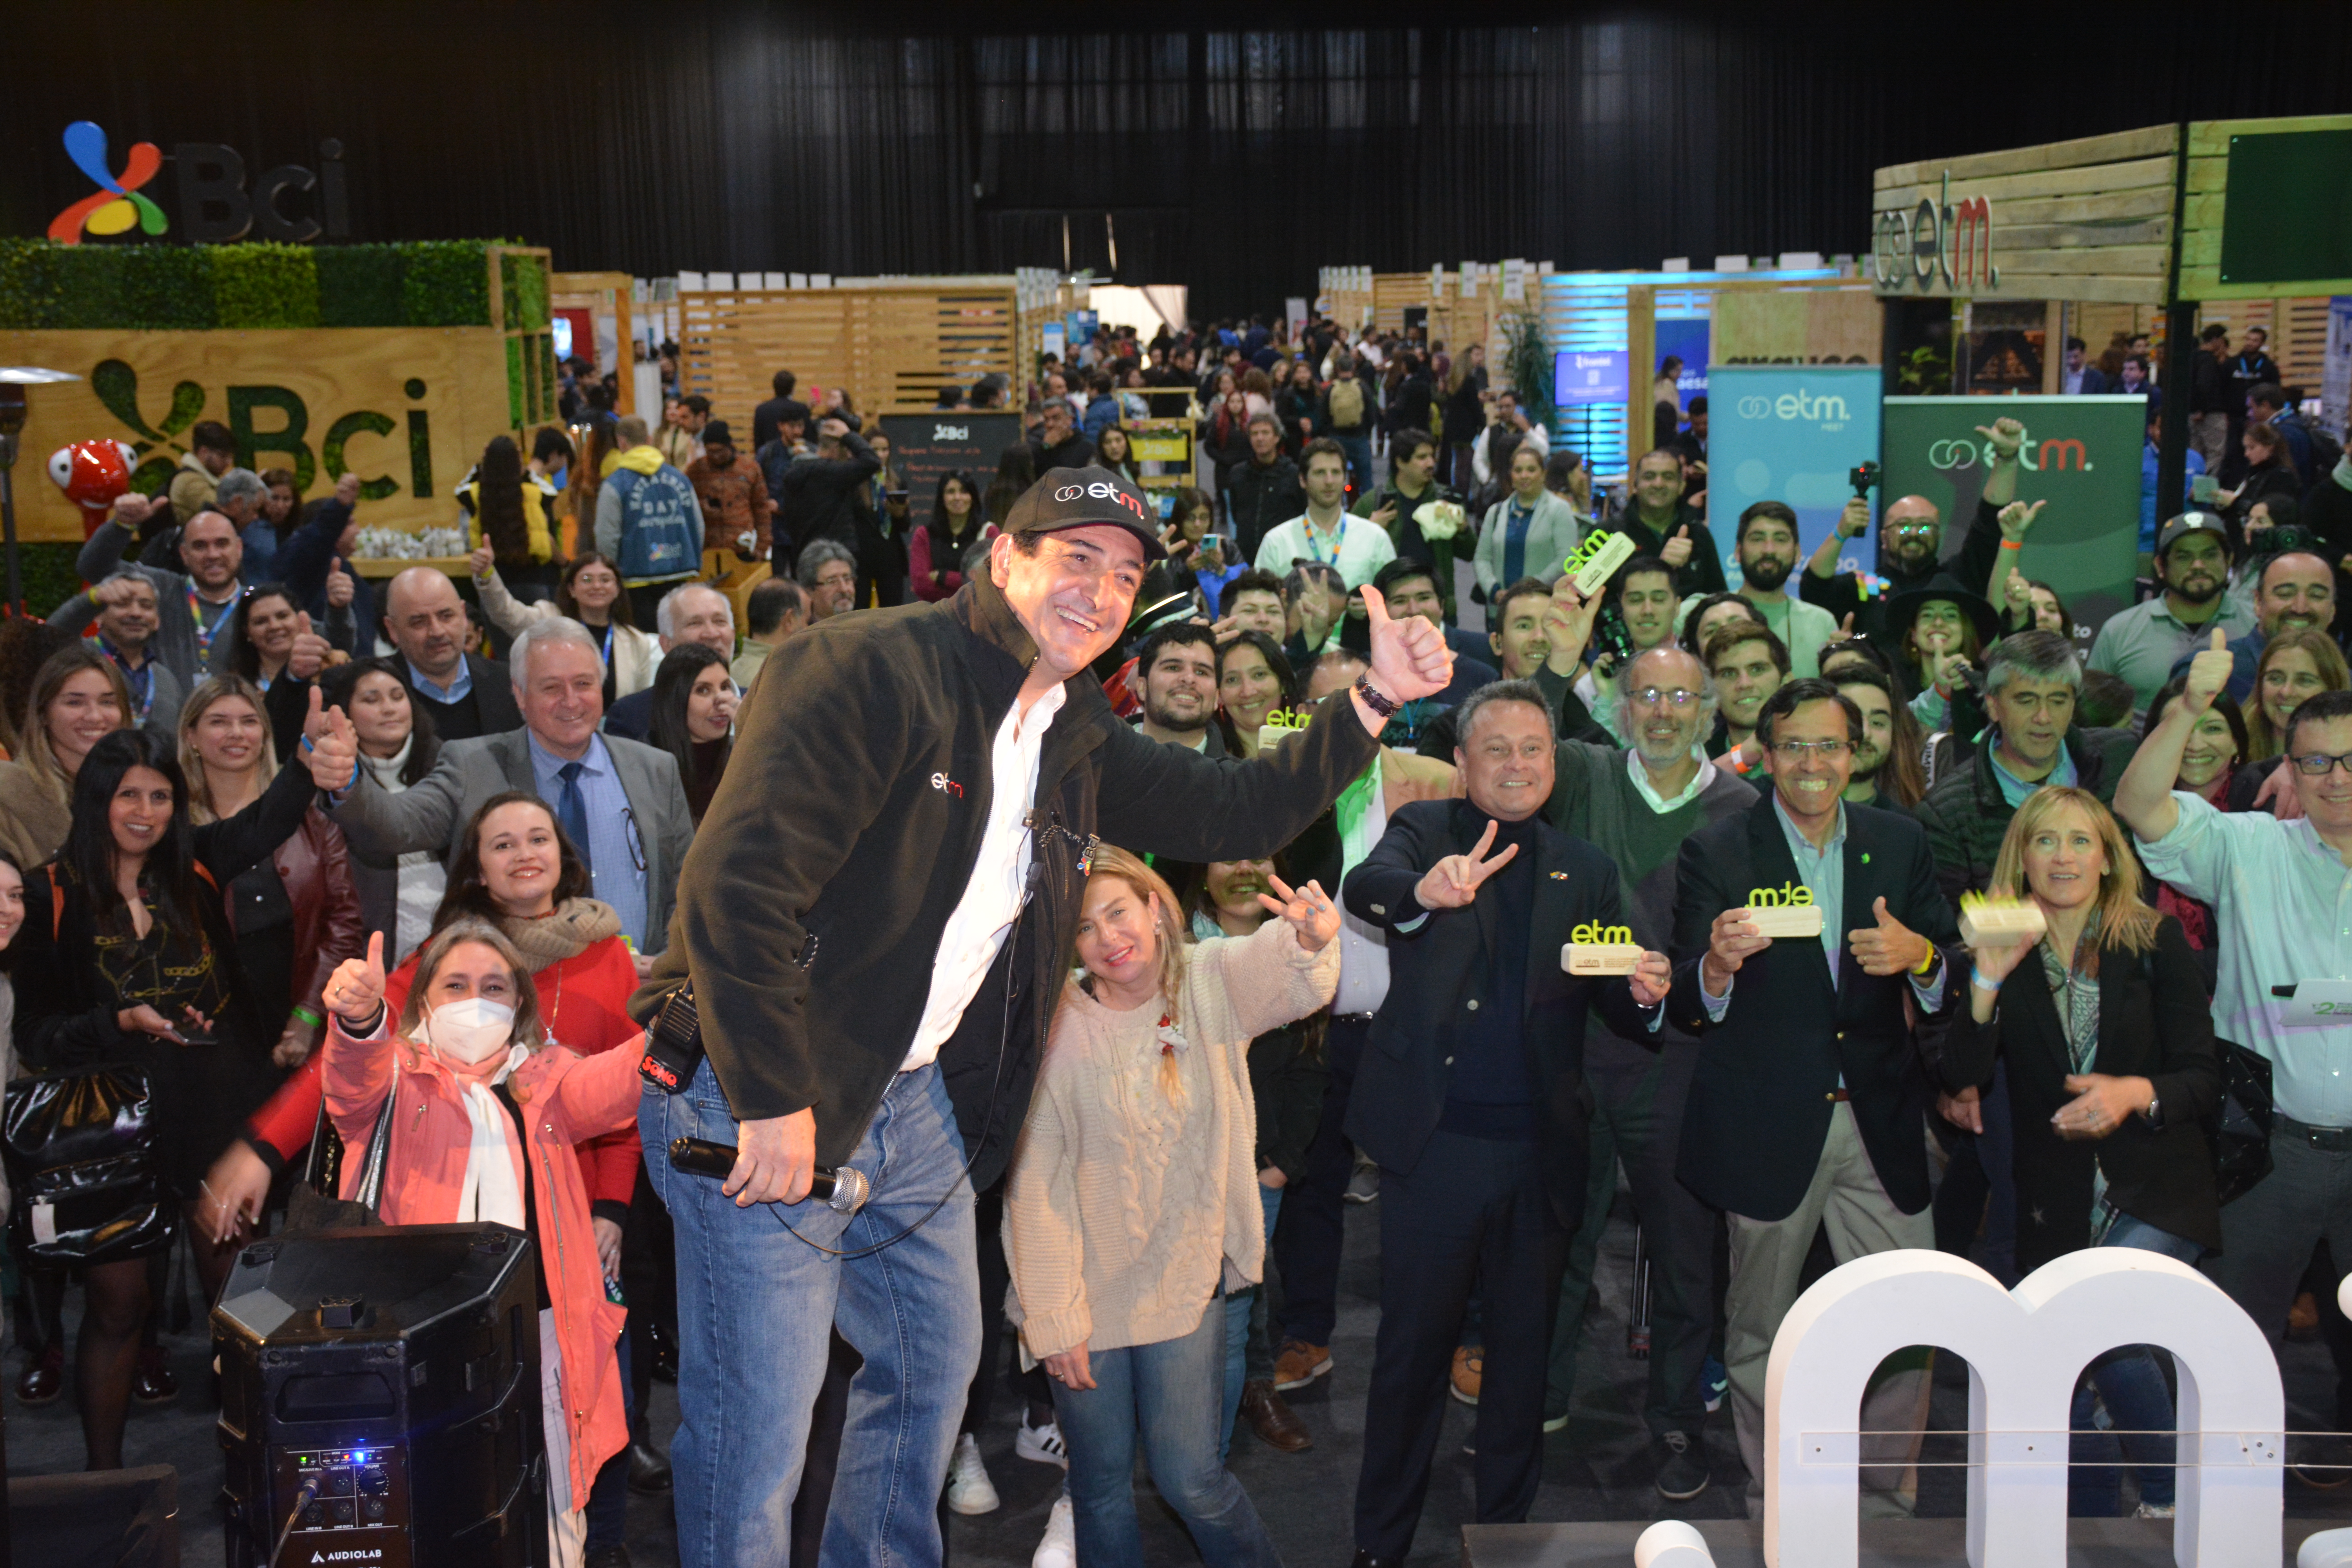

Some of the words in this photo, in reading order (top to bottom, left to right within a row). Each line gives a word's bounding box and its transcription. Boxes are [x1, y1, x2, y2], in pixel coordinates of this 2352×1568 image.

[176, 137, 351, 241] Bci
[1676, 377, 1708, 390] aesa
[227, 378, 433, 501] Bci
[931, 772, 963, 798] etm
[1082, 833, 1101, 860] Bci
[328, 1549, 382, 1561] AUDIOLAB
